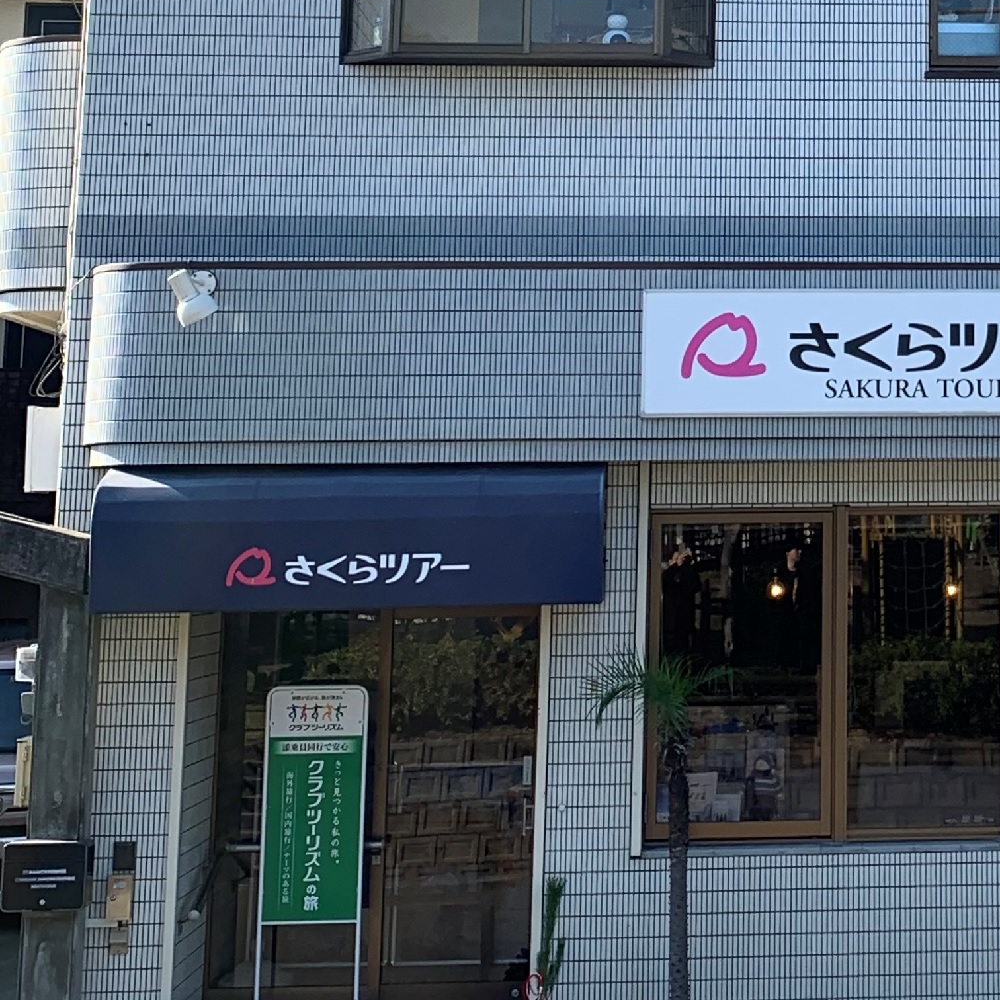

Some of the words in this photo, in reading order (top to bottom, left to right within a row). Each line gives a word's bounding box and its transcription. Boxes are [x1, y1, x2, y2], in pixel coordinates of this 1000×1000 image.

[824, 378, 927, 399] SAKURA
[285, 553, 470, 586] さくらツアー
[303, 760, 326, 911] クラブツーリズムの旅
